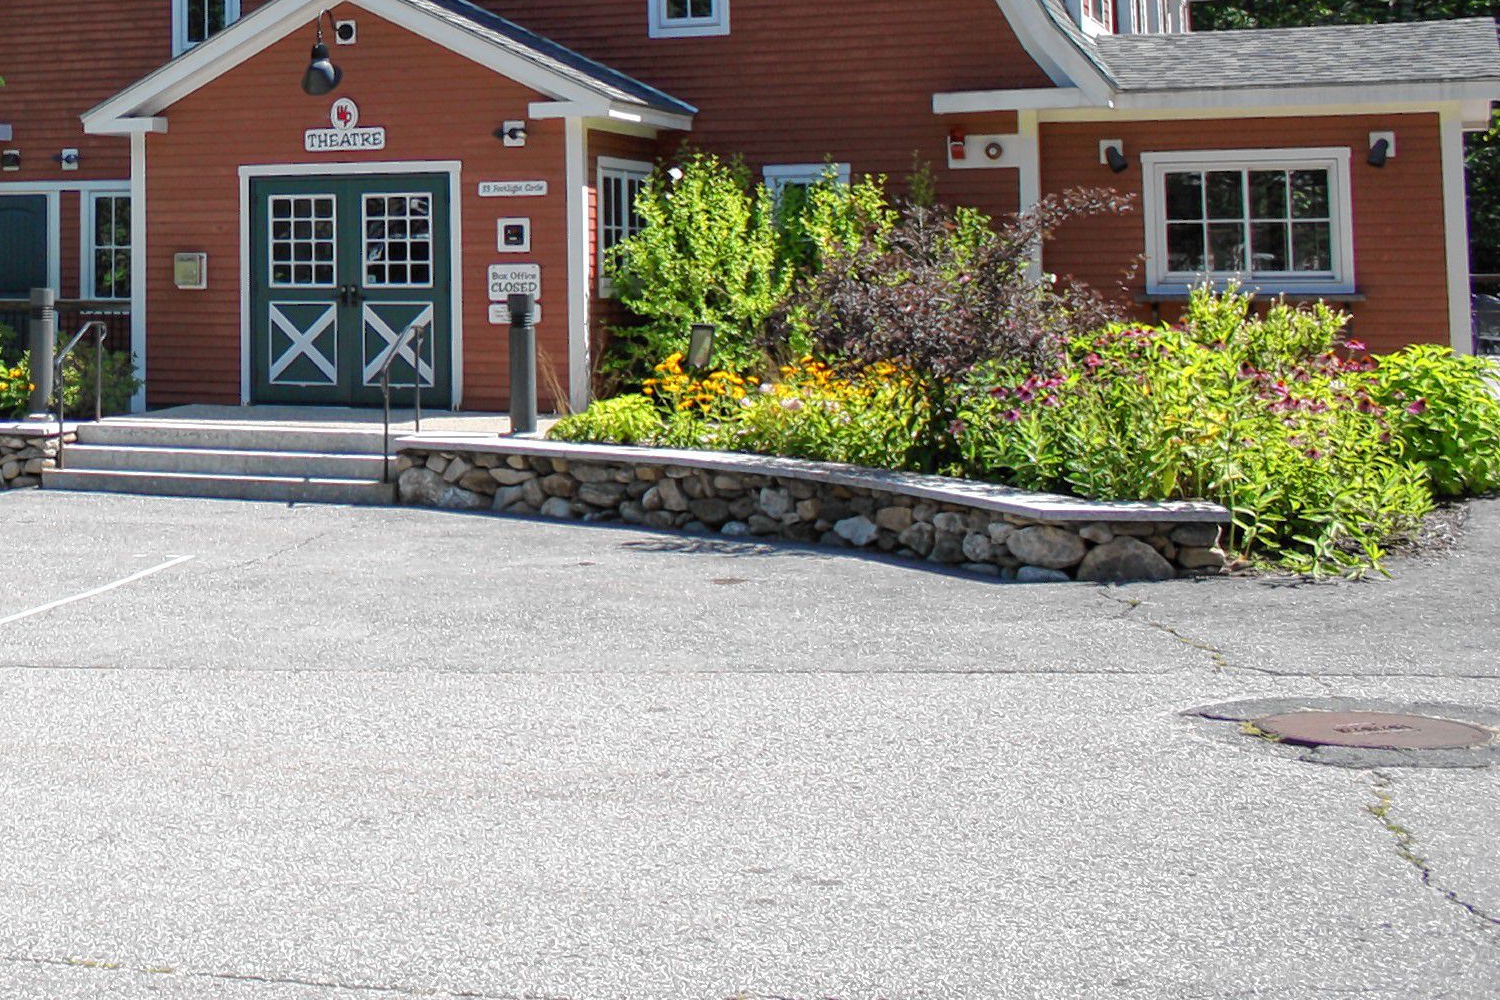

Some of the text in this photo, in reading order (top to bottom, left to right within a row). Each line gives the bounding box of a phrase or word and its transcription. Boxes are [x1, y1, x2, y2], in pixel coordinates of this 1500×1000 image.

[307, 132, 382, 148] THEATRE
[492, 271, 537, 280] Box Office
[491, 282, 537, 293] CLOSED
